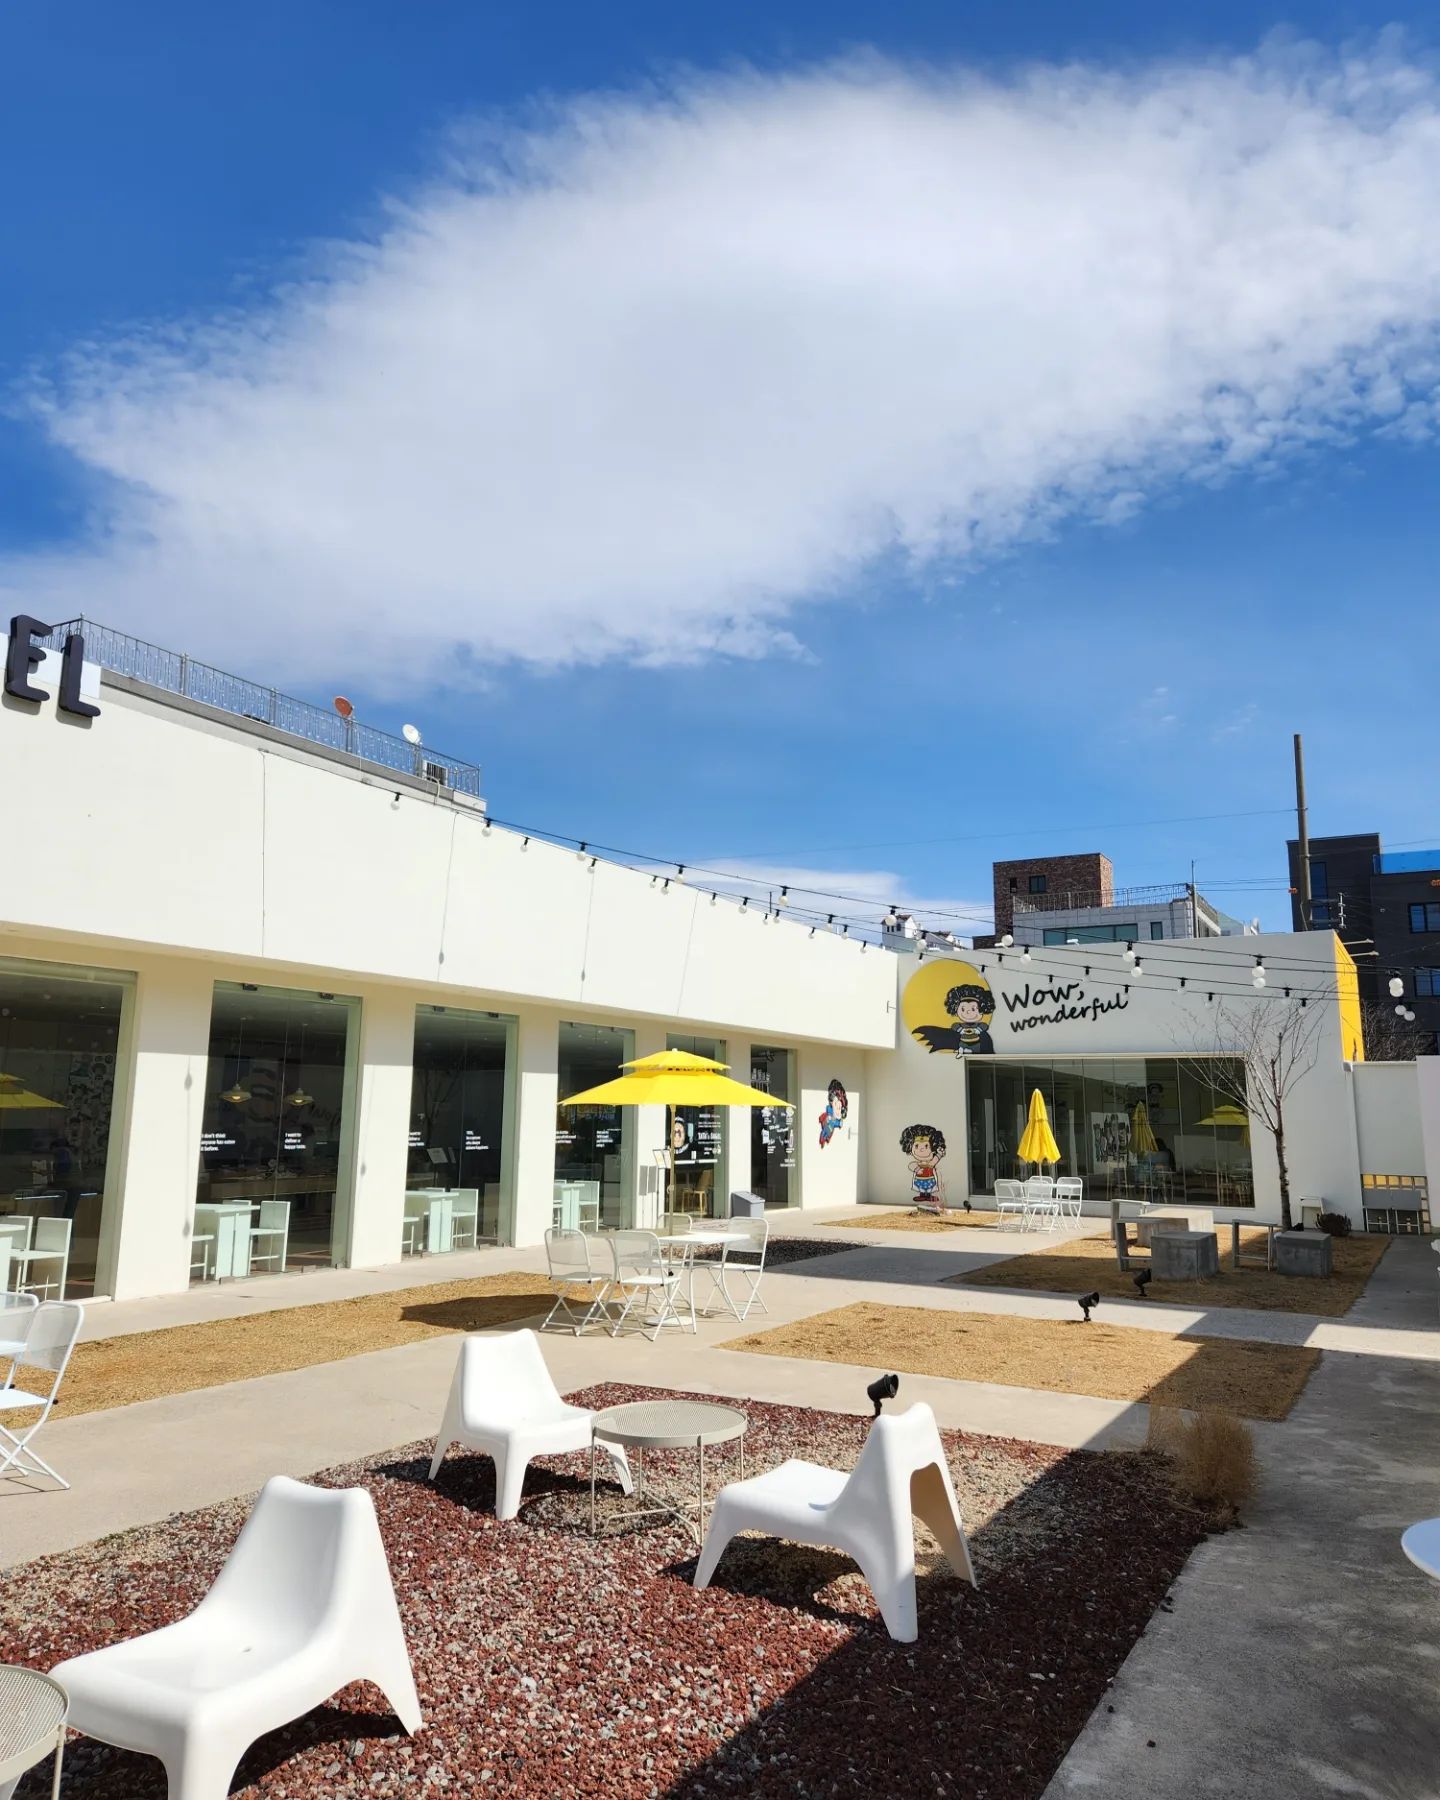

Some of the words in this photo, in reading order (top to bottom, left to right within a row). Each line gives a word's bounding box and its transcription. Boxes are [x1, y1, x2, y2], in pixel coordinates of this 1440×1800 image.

[5, 614, 101, 717] EL
[1001, 983, 1085, 1013] Wow,
[1010, 993, 1129, 1033] wonderful
